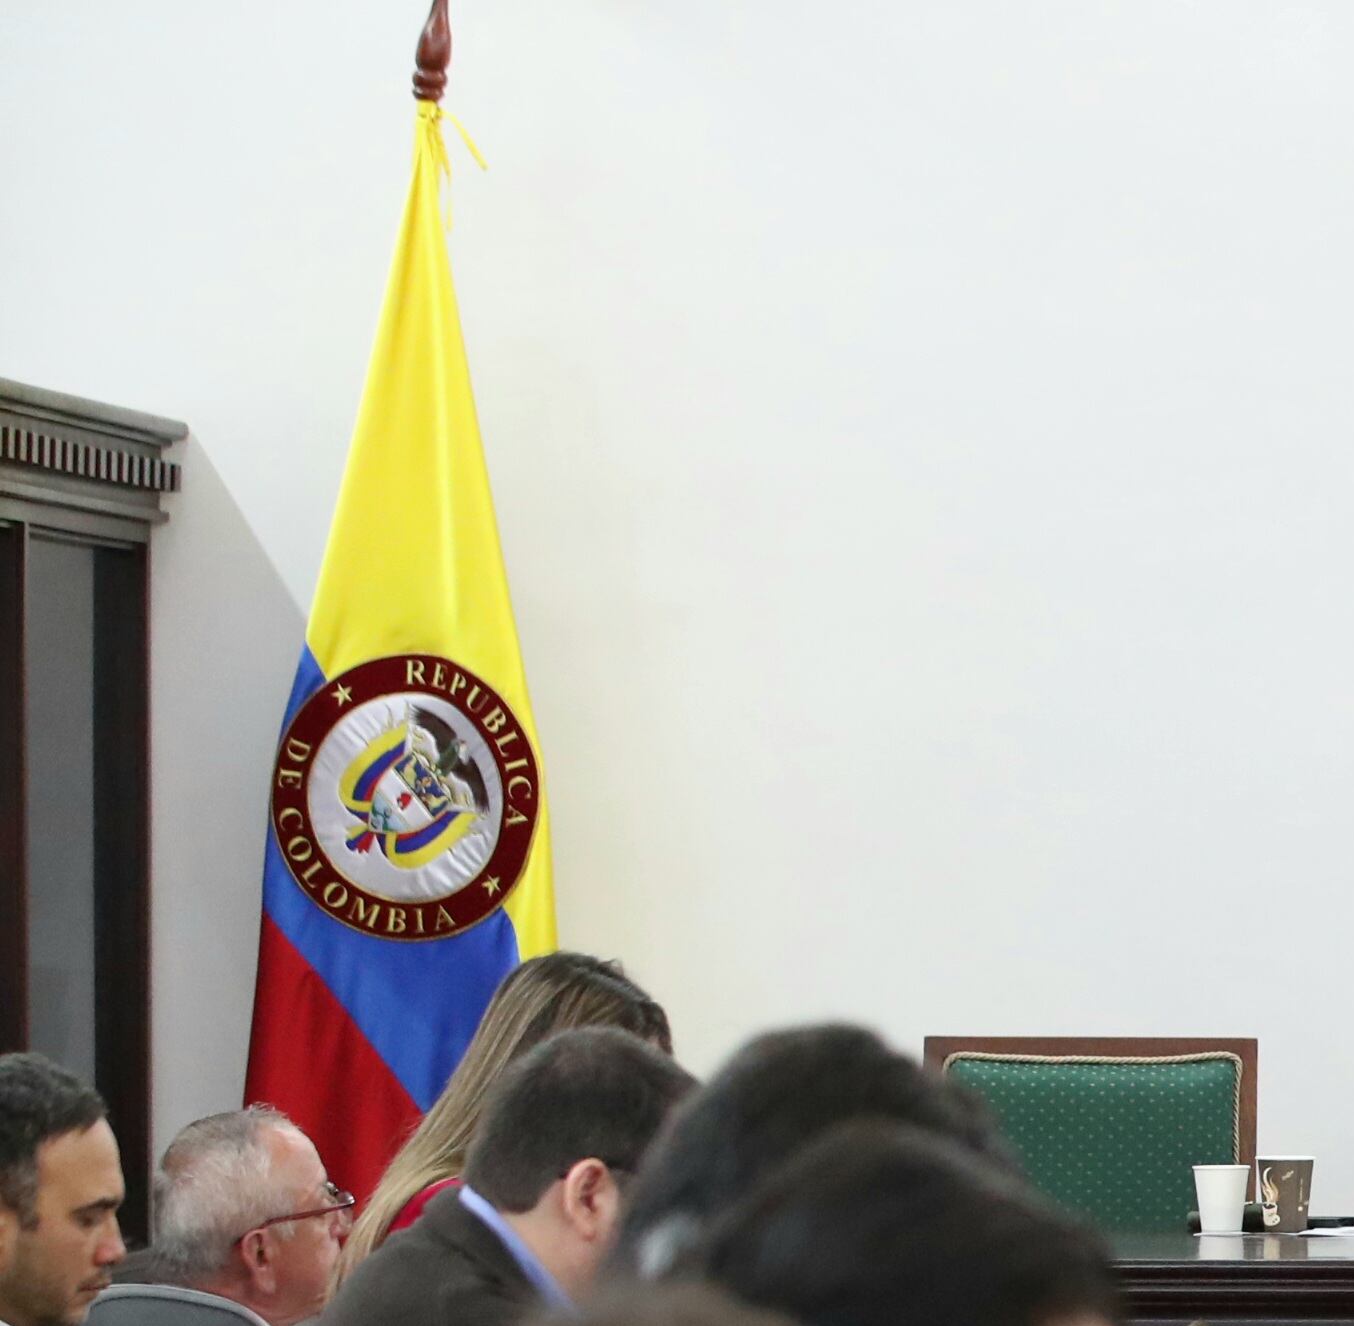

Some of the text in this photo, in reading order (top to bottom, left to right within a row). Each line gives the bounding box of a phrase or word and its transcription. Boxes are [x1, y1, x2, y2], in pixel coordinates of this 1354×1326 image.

[405, 658, 533, 828] REPUBLICA
[276, 737, 457, 932] DE COLOMBIA
